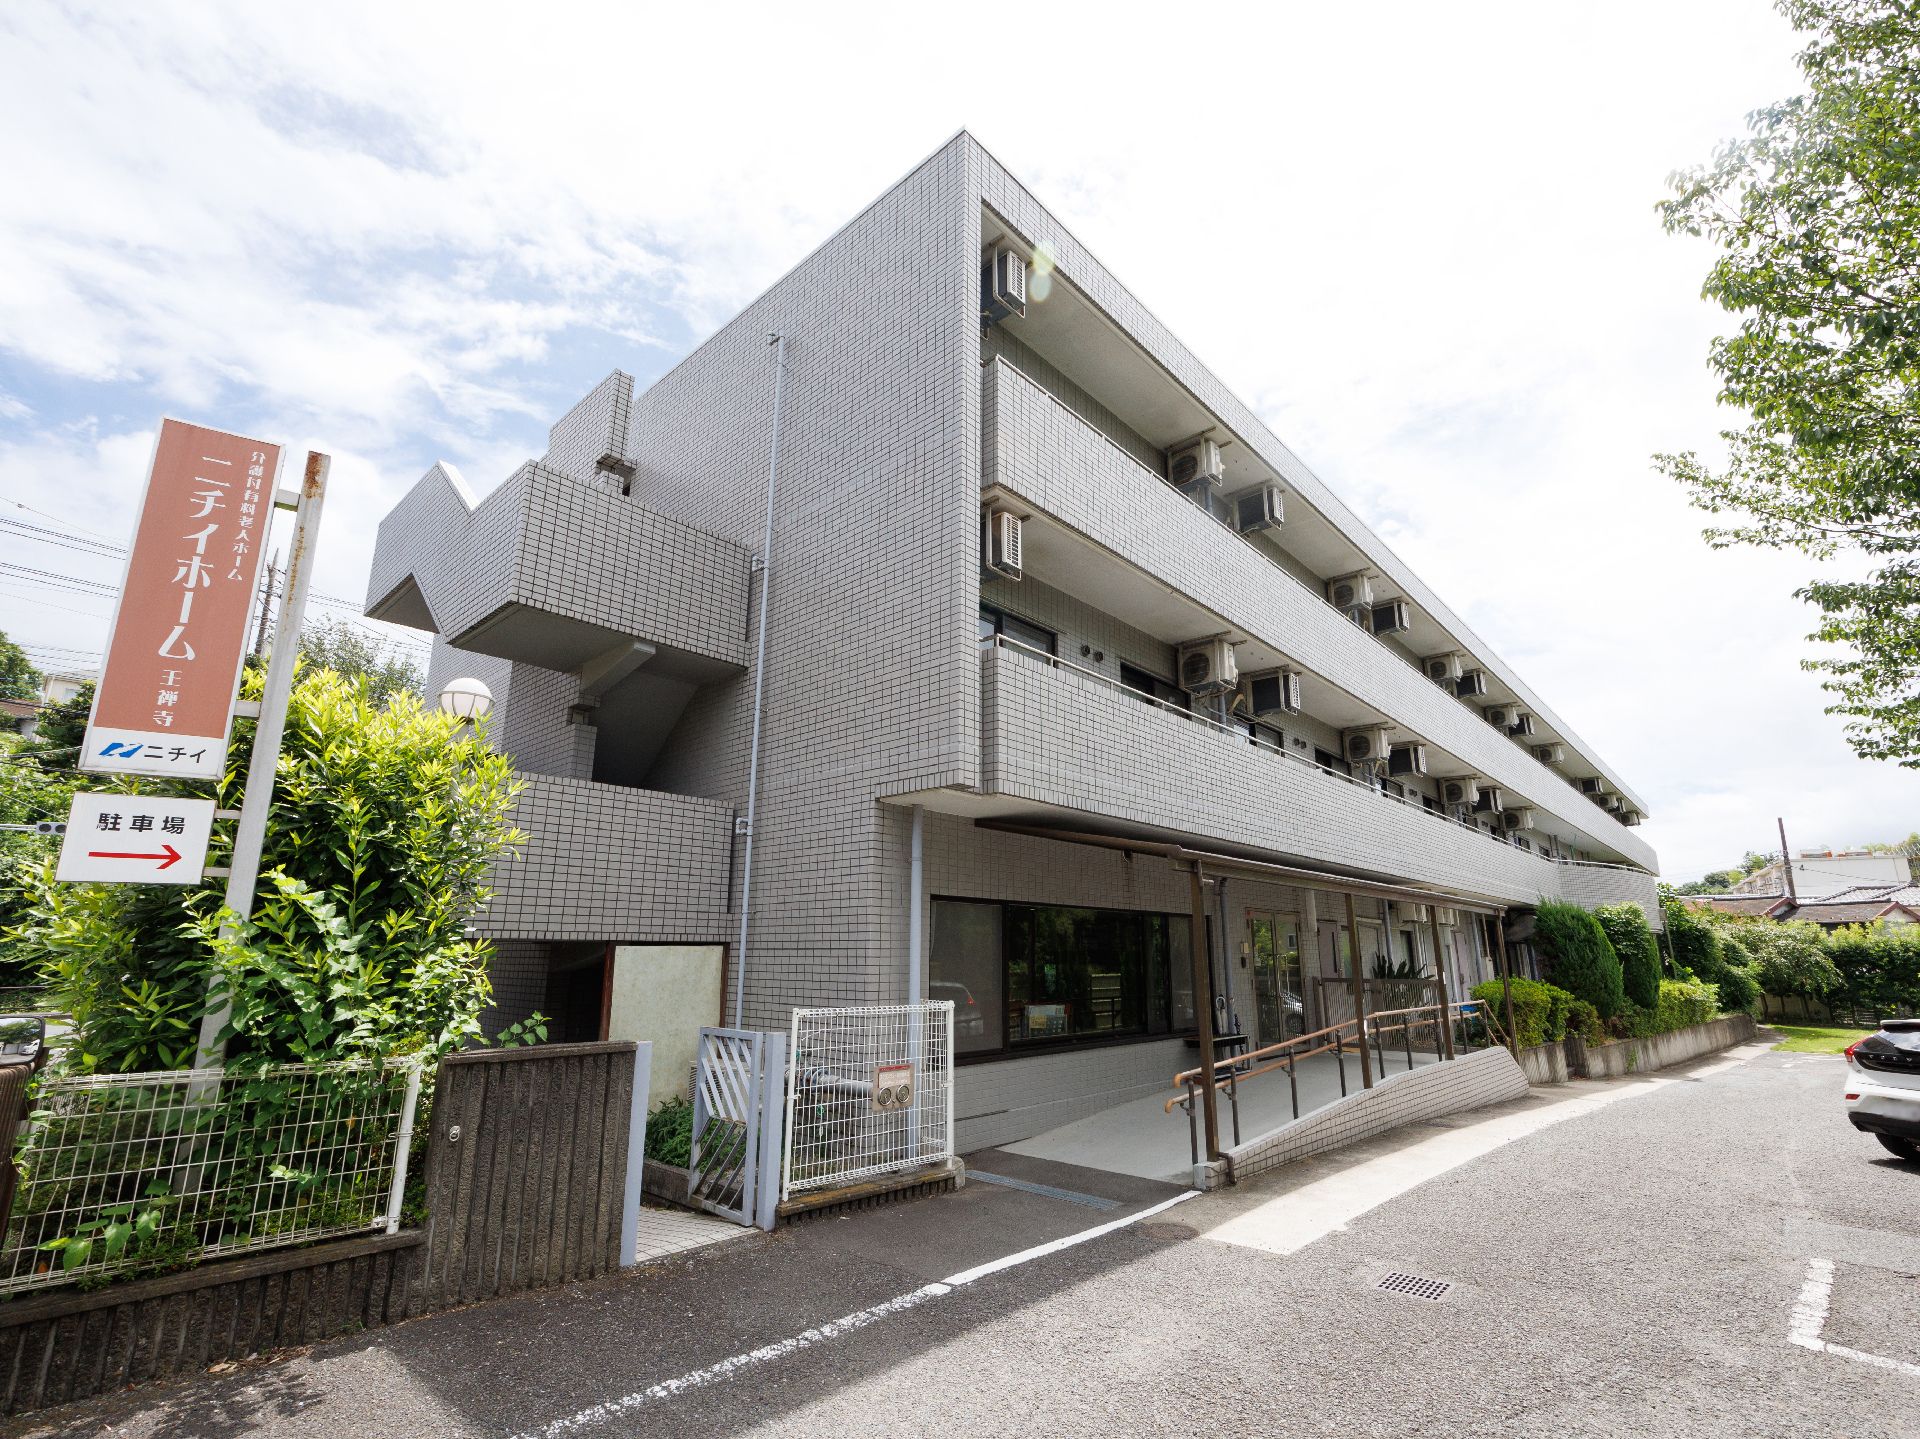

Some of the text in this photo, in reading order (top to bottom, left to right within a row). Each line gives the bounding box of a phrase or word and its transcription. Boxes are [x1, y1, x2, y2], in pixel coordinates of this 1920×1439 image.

[228, 451, 266, 580] 介護付有料老人ホーム
[153, 456, 232, 727] ニチイホーム 王禅寺
[144, 745, 207, 763] ニチイ
[96, 812, 186, 835] 駐車場
